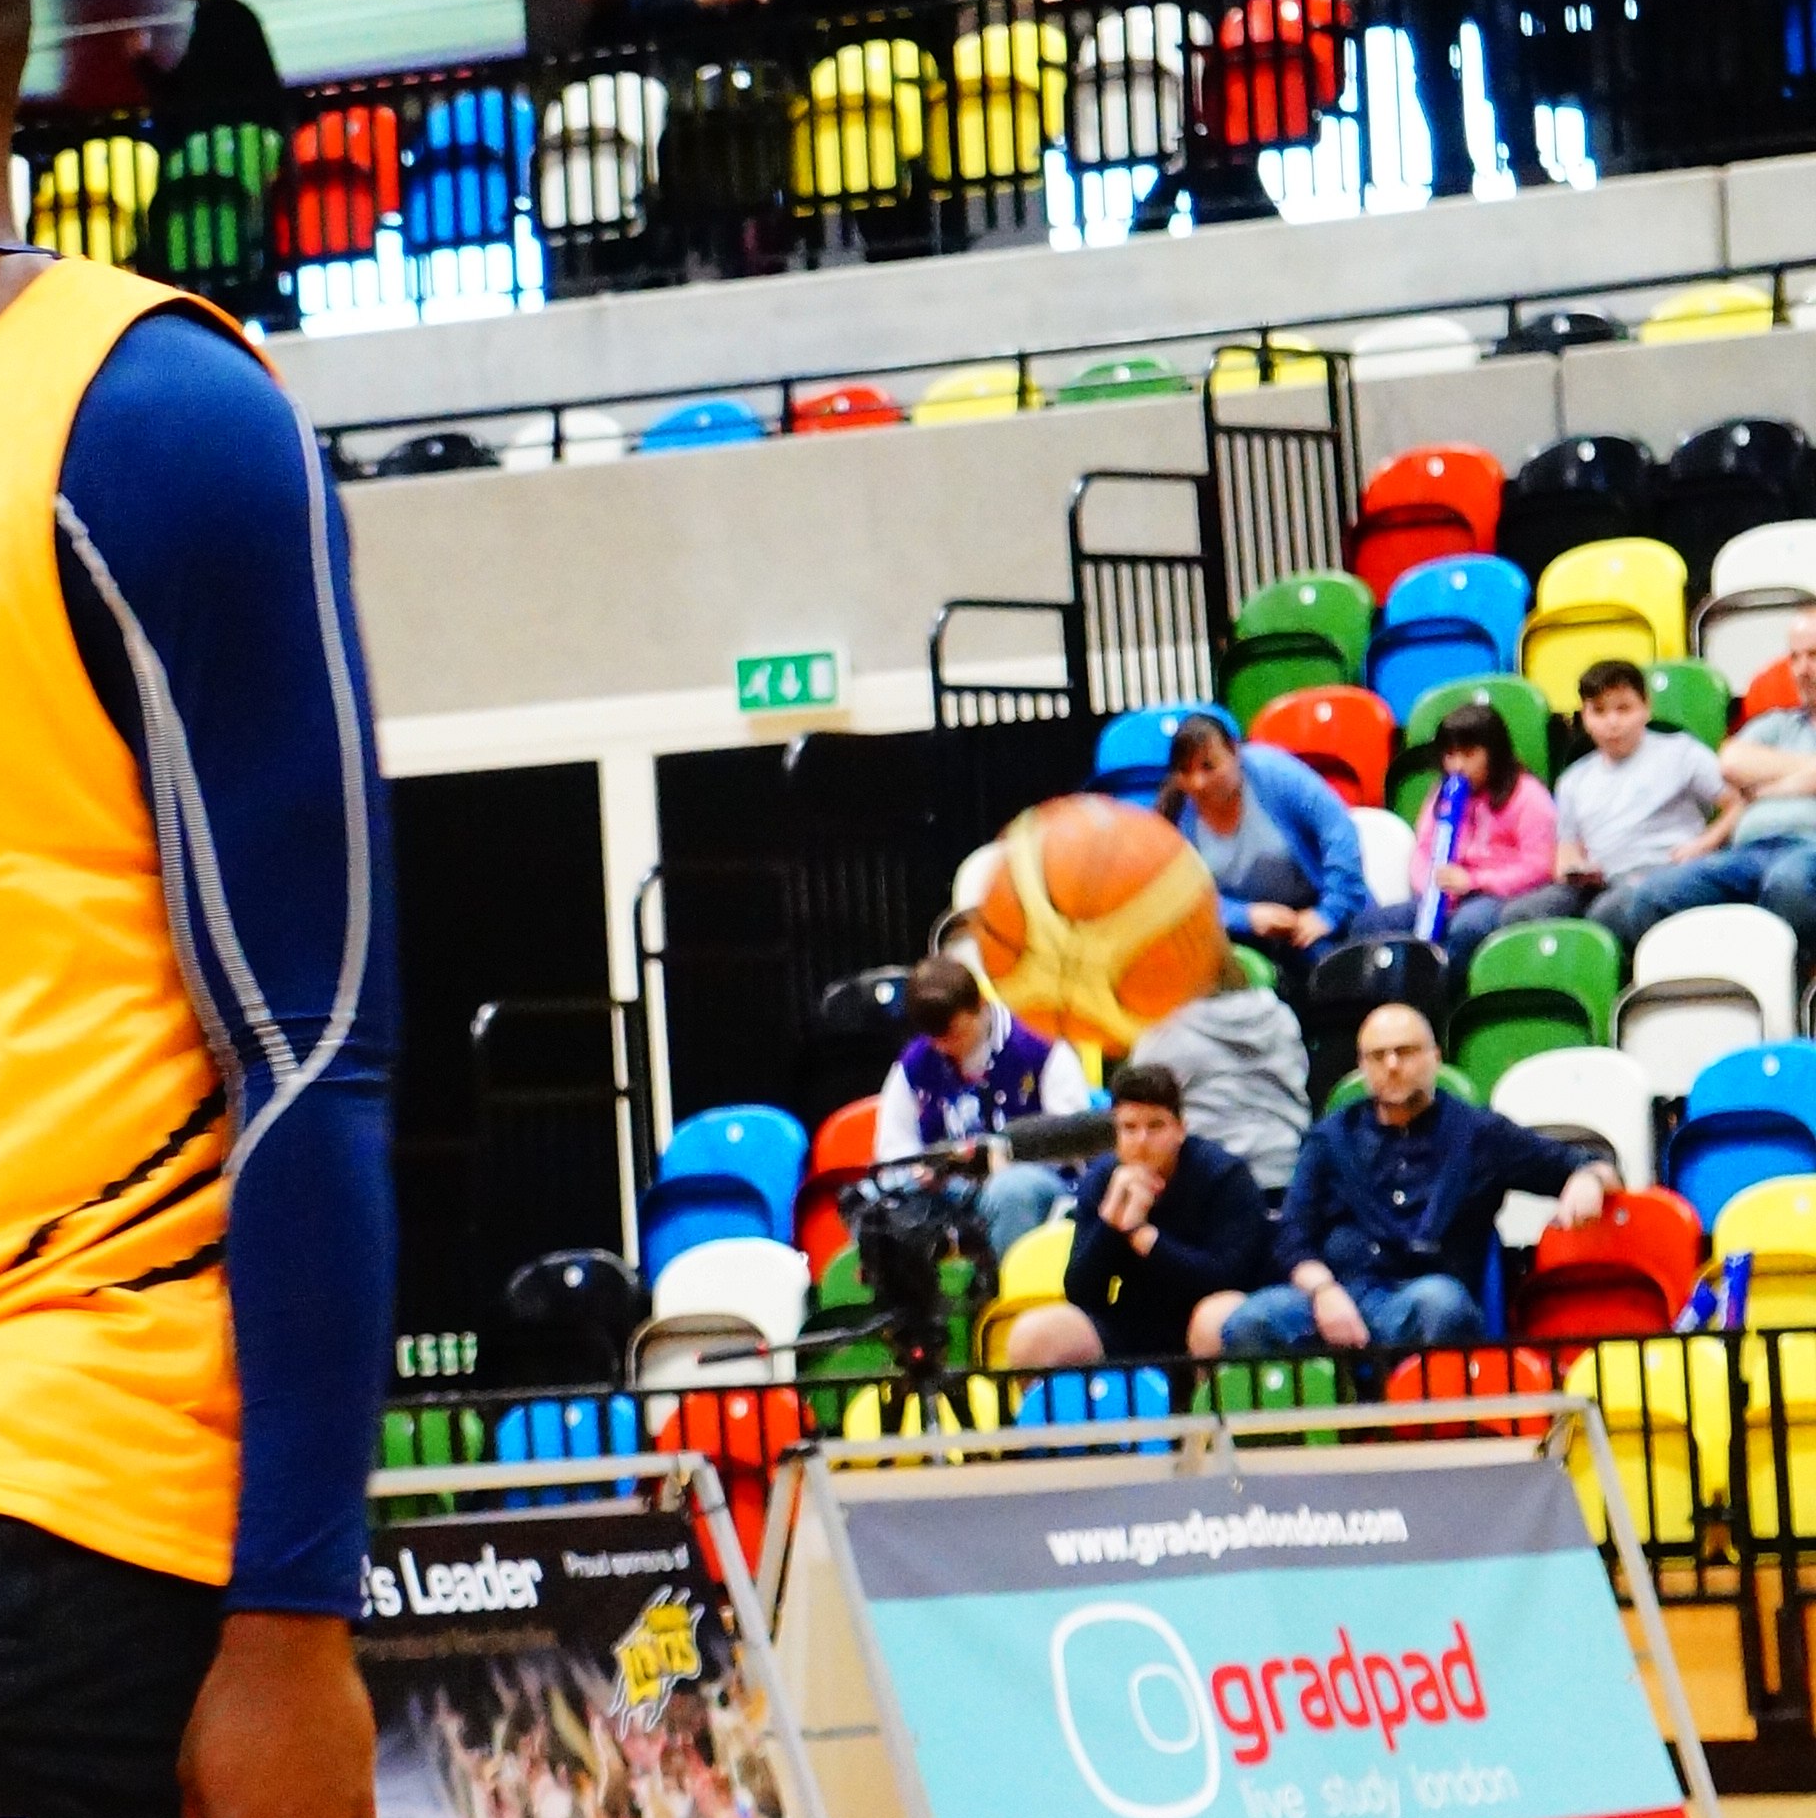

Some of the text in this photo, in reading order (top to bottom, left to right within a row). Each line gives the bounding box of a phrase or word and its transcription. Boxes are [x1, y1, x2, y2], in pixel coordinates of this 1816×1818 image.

[1045, 1503, 1409, 1567] www.gradpadlondon.com
[398, 1542, 543, 1615] Leader
[1211, 1618, 1488, 1767] gradpad
[1409, 1757, 1521, 1811] london
